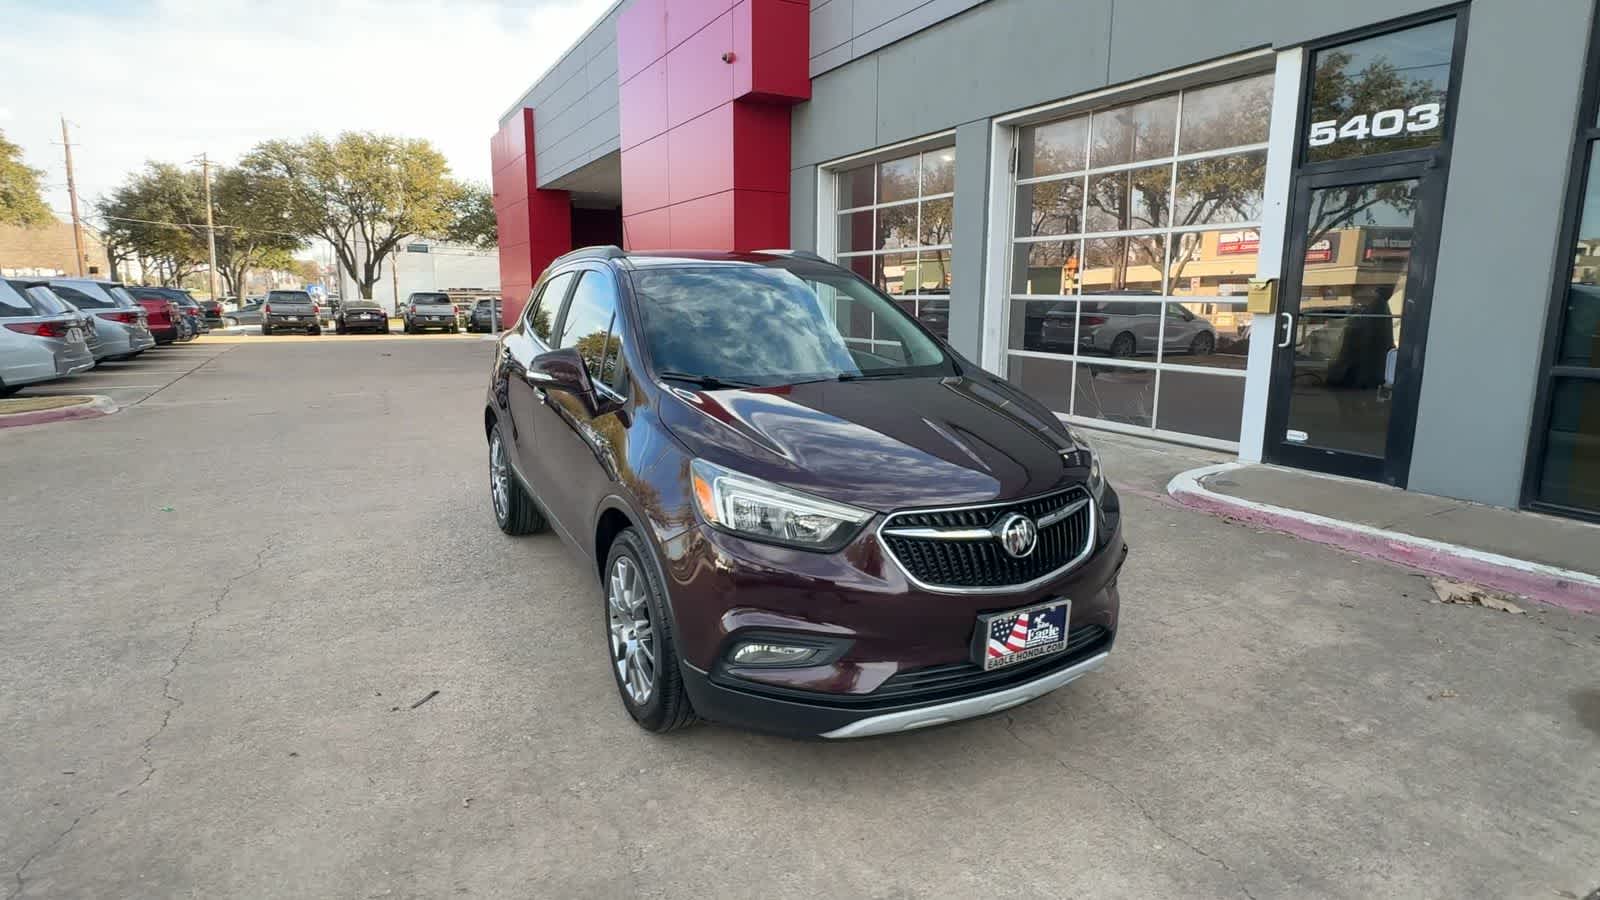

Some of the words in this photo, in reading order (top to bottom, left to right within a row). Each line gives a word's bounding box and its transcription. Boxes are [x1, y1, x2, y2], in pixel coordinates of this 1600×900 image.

[1308, 103, 1440, 147] 5403
[1028, 624, 1059, 640] Eagle
[988, 654, 1015, 669] EAGLE
